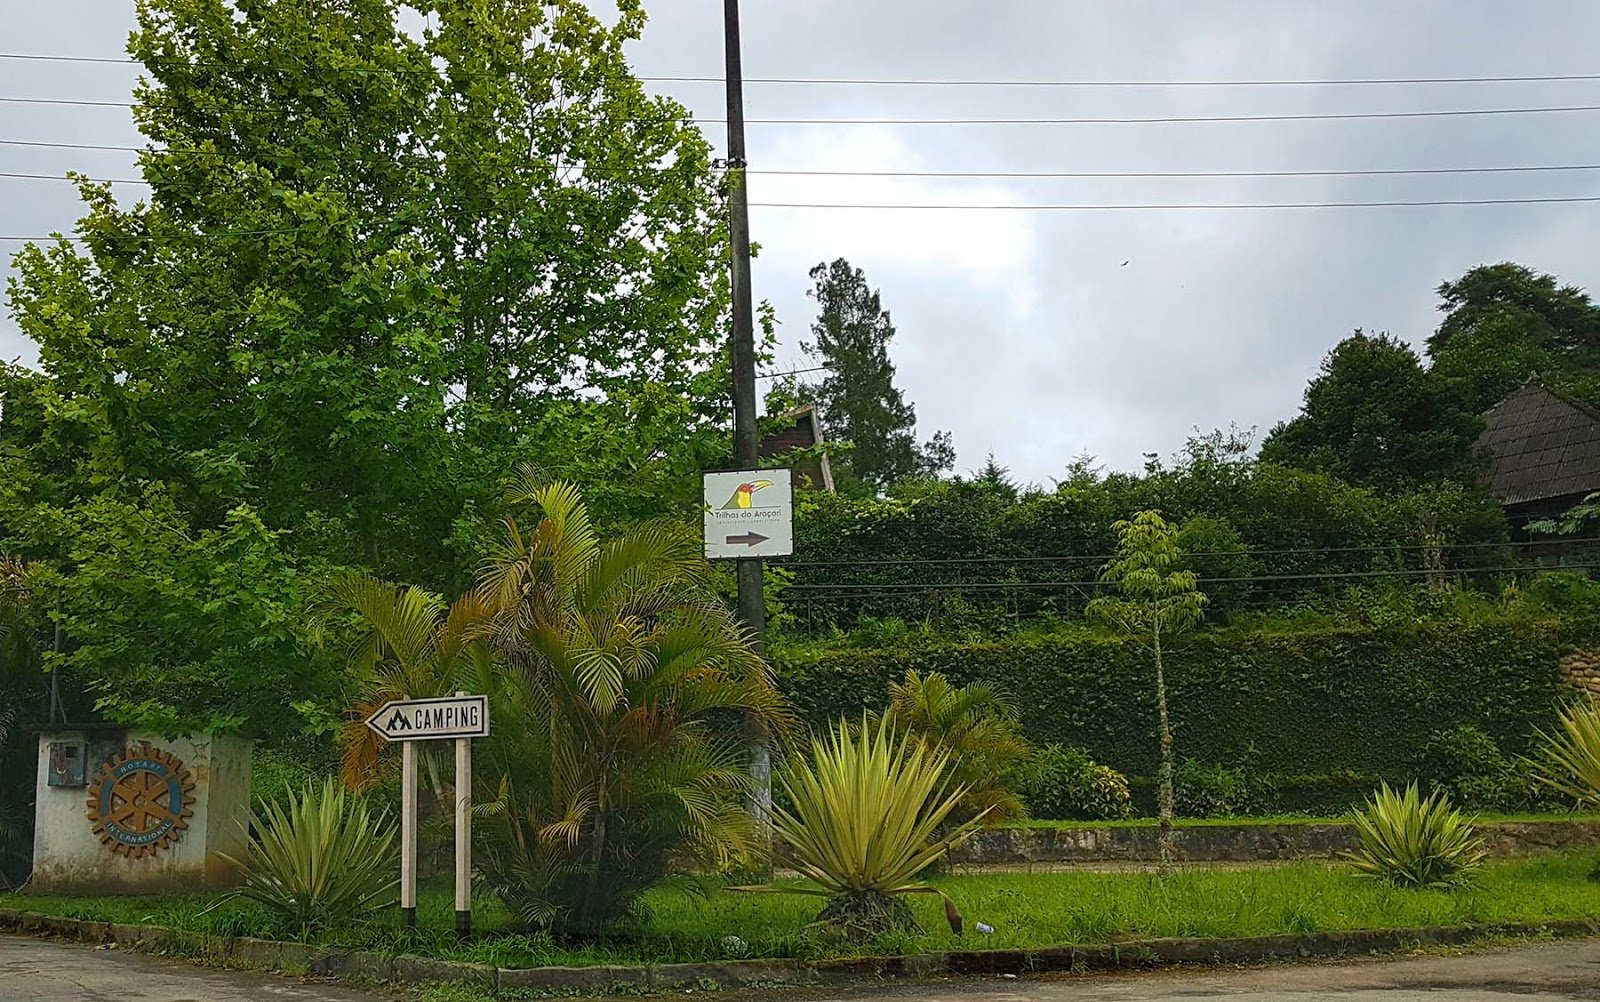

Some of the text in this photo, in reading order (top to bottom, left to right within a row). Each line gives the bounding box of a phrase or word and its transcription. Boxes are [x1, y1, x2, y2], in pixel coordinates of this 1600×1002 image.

[715, 511, 739, 519] Trilhas
[741, 510, 751, 518] do
[415, 706, 478, 729] CAMPING
[120, 761, 160, 773] ROTARY
[107, 822, 172, 843] INTERNATIONAL
